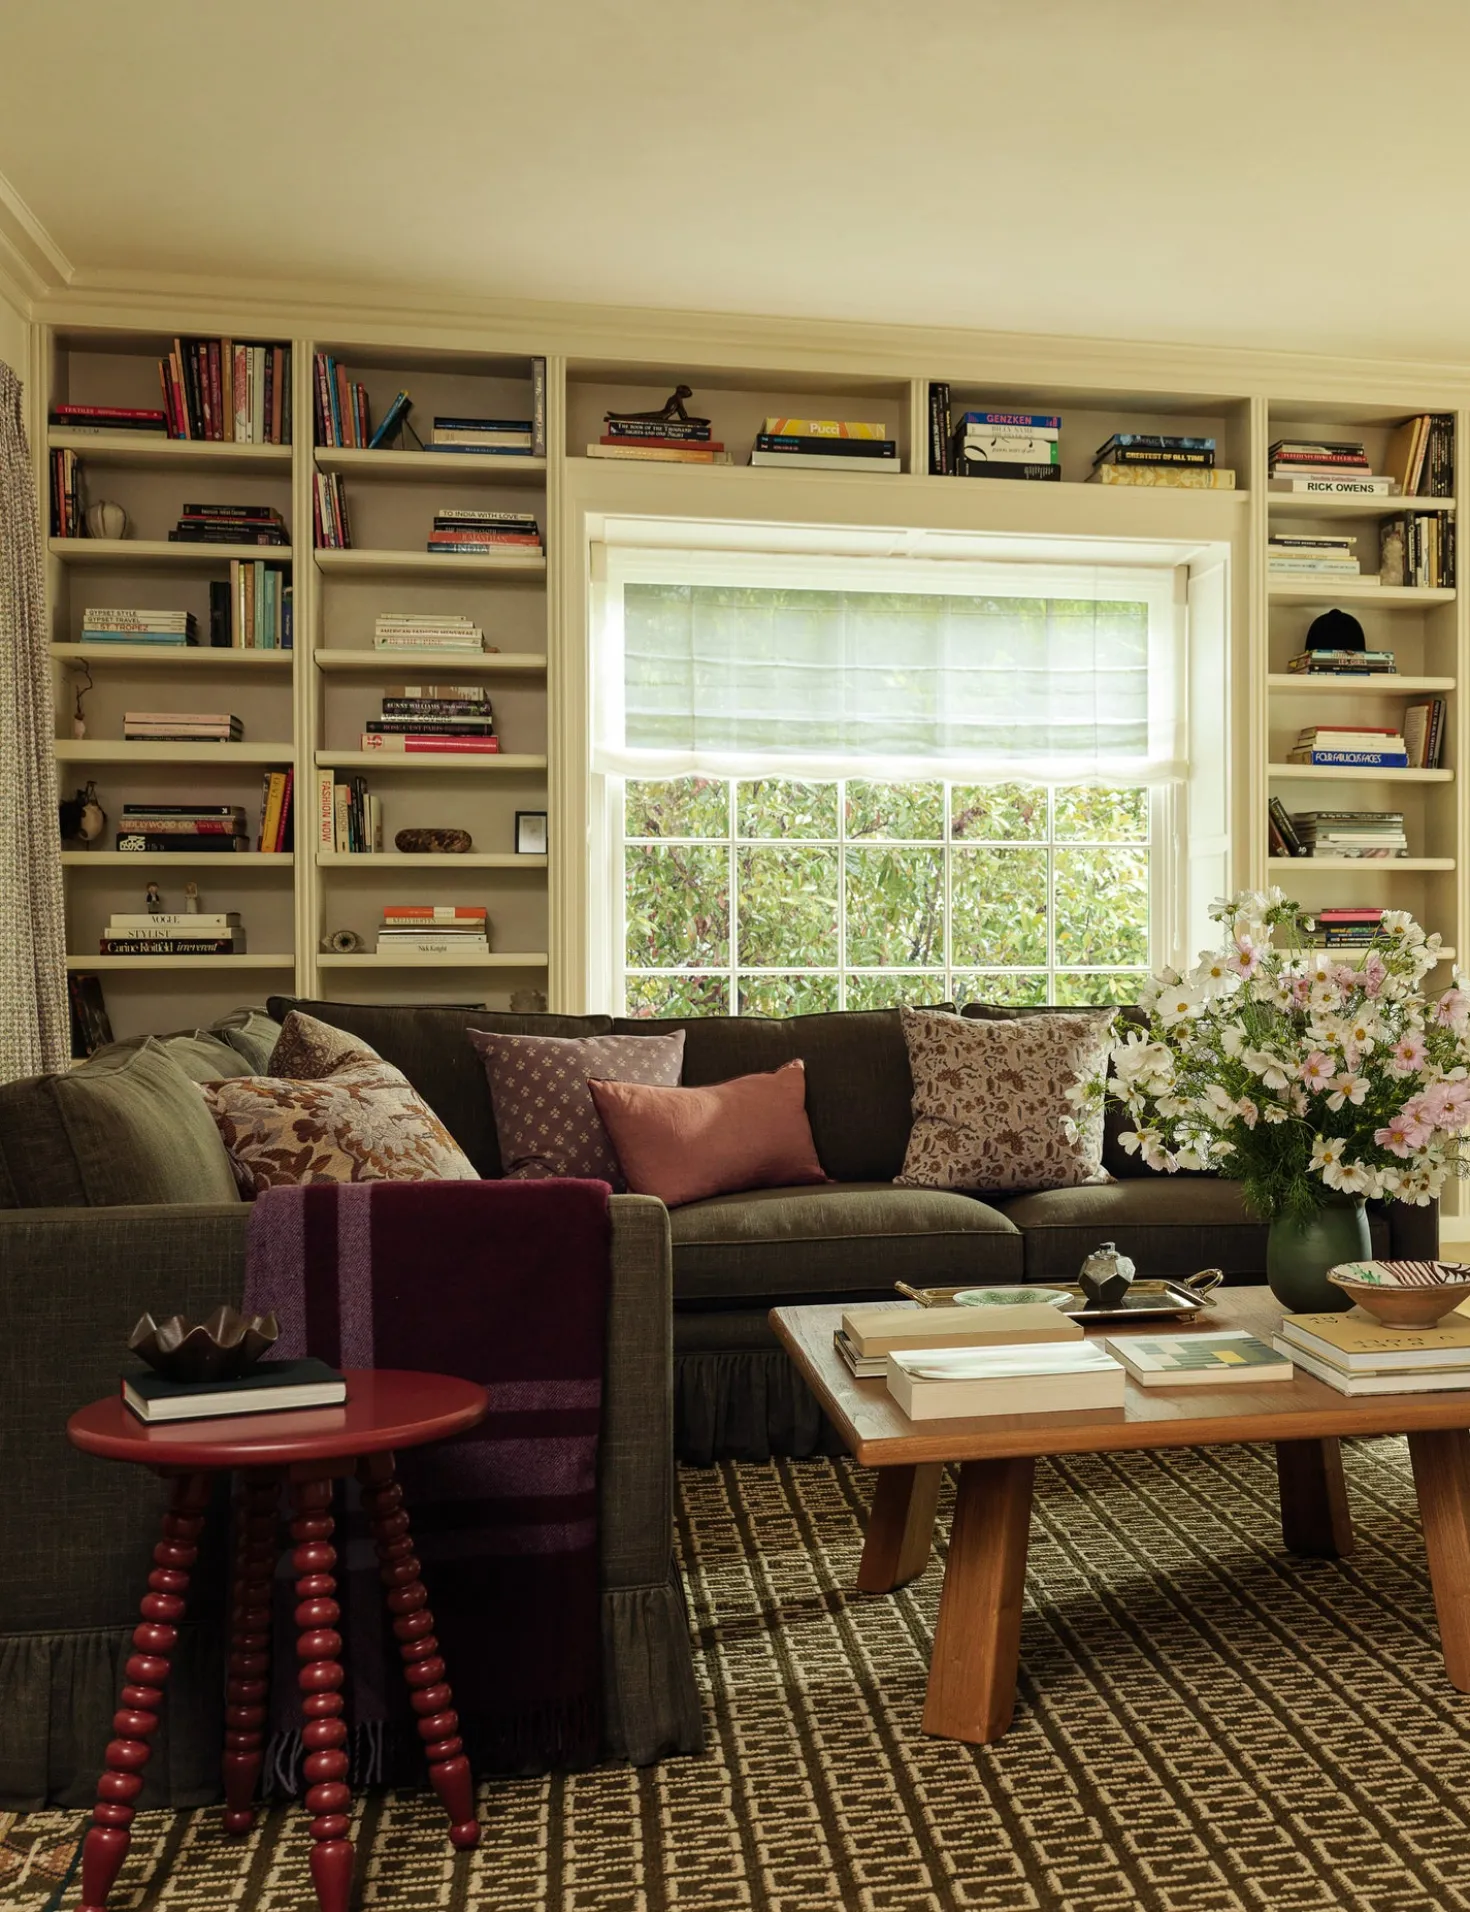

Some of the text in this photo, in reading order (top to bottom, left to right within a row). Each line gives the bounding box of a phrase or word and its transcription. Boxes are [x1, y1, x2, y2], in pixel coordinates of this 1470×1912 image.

[986, 414, 1032, 425] GENZKEN
[809, 422, 840, 435] Pucci
[1126, 452, 1161, 460] GREATEST
[1307, 482, 1374, 493] RICK OWENS
[114, 624, 149, 632] TROPEZ
[1315, 752, 1382, 763] FOUR FABULOUS FACES
[322, 780, 331, 844] FASHION NOW
[337, 799, 348, 833] FASHION
[151, 915, 180, 924] VOGUE
[128, 929, 171, 939] STYLIST
[107, 942, 218, 953] Carine Roitfeld irreverent
[430, 945, 447, 953] Knight
